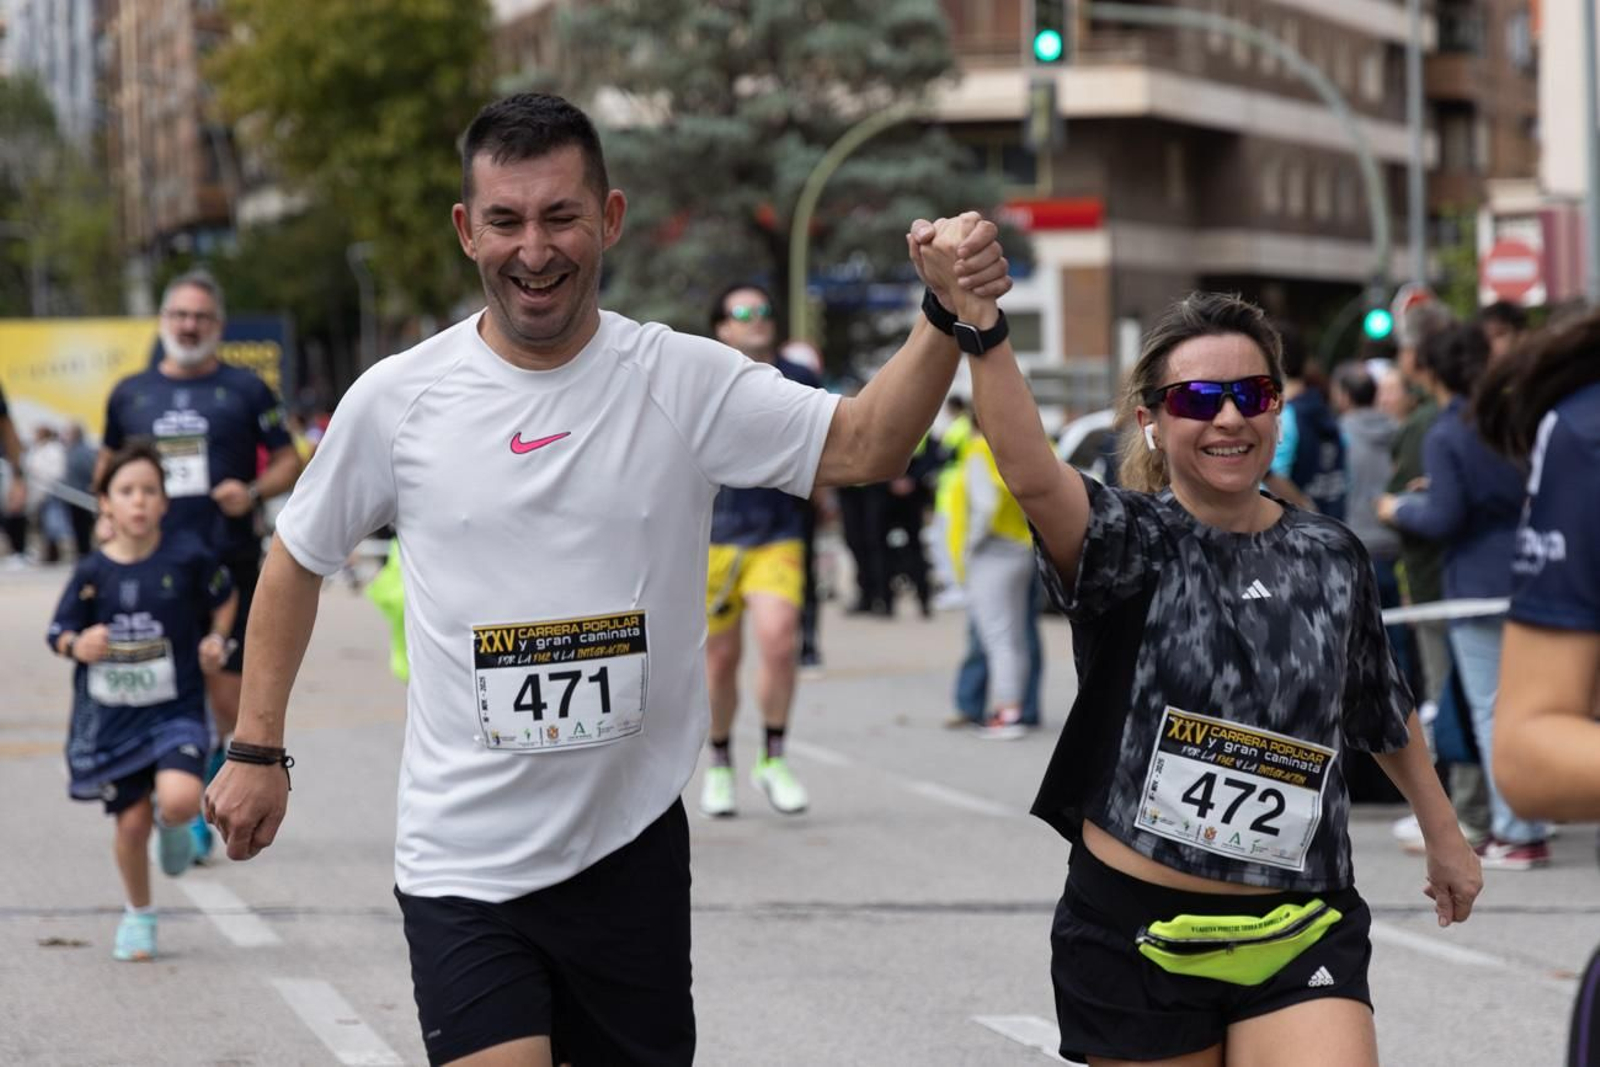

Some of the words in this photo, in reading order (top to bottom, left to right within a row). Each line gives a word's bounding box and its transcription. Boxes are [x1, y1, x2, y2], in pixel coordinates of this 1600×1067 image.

[479, 629, 515, 653] XXV
[518, 623, 580, 639] CARRERA
[582, 616, 640, 632] POPULAR
[518, 639, 528, 651] y
[536, 635, 572, 650] gran
[580, 627, 640, 643] caminata
[513, 666, 611, 721] 471
[1167, 717, 1209, 745] XXV
[1210, 726, 1268, 749] CARRERA
[1269, 741, 1325, 764] POPULAR
[1208, 737, 1217, 748] y
[1223, 741, 1258, 757] gran
[1264, 751, 1320, 774] caminata
[1181, 771, 1286, 837] 472
